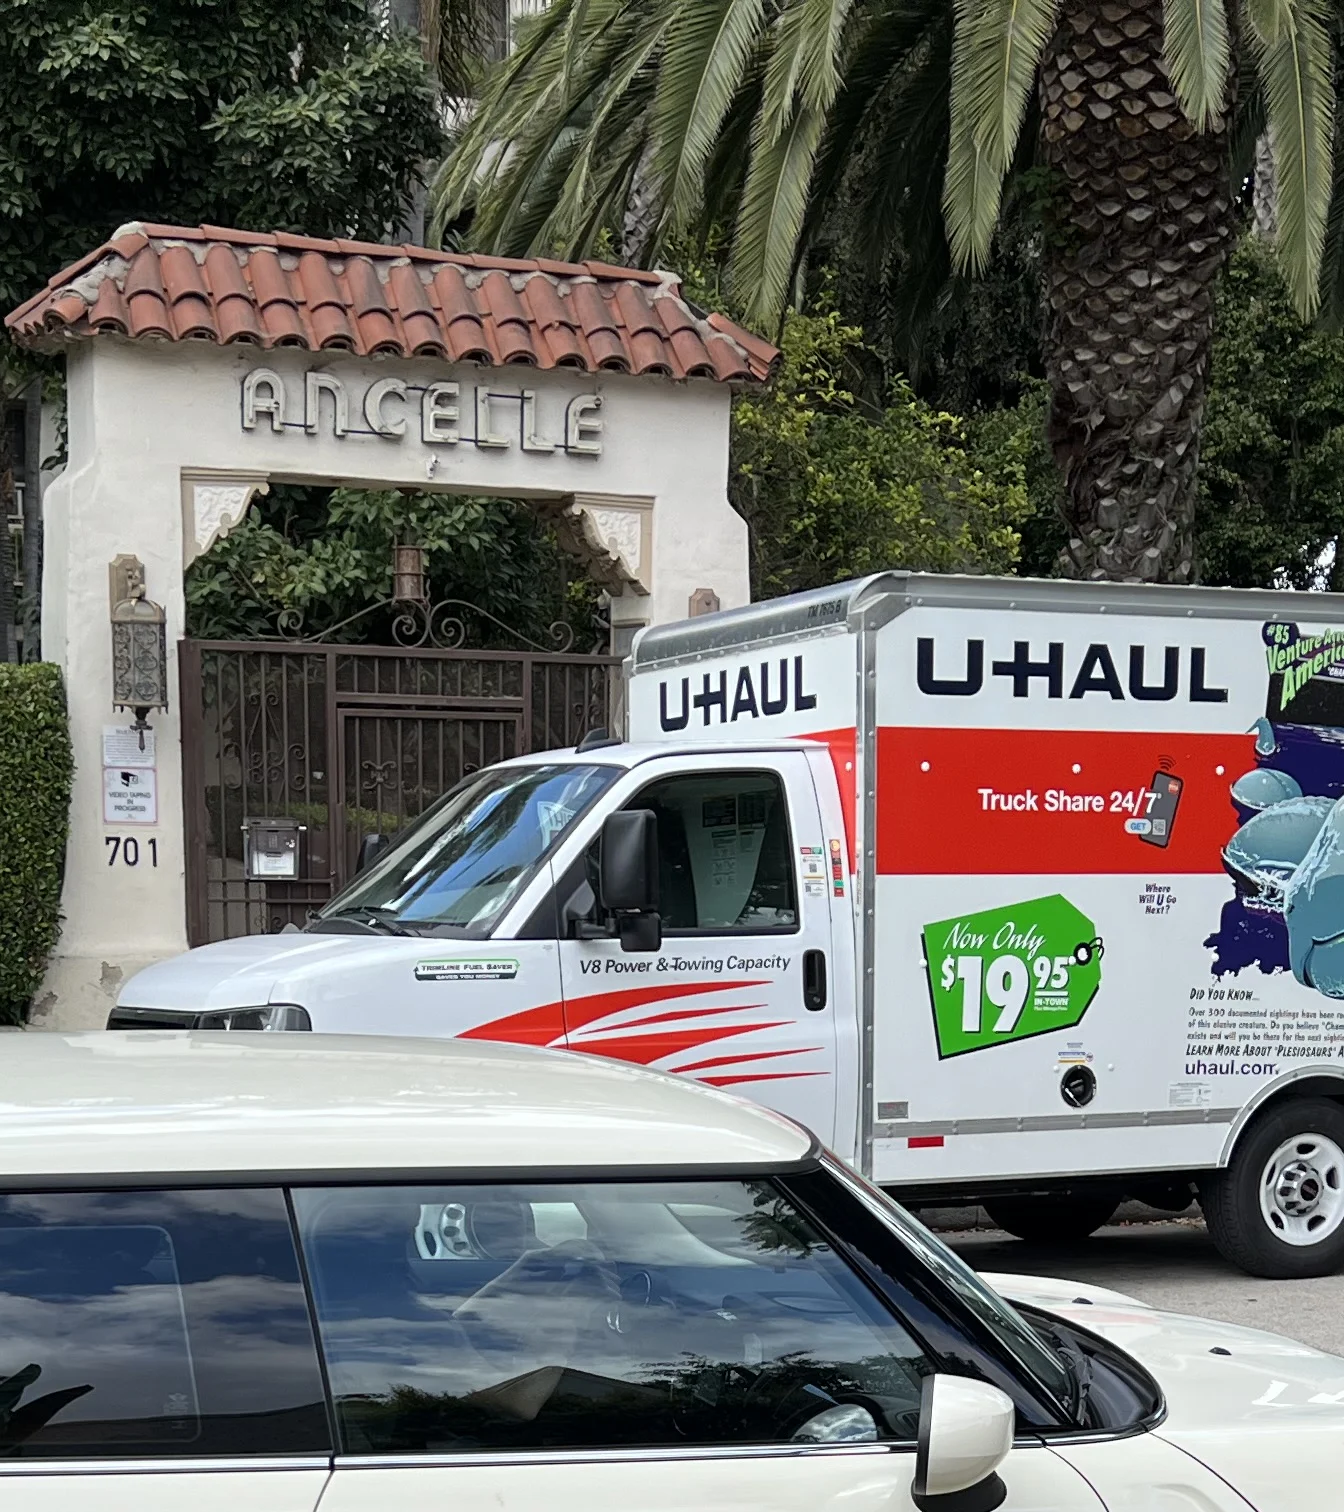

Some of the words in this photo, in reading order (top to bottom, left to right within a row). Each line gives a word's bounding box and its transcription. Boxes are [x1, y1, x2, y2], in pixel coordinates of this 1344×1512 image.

[241, 367, 604, 455] ANCELLE
[1266, 623, 1290, 644] #85
[1265, 634, 1323, 676] Venture
[917, 637, 1229, 703] U-HAUL
[659, 655, 817, 732] U-HAUL
[977, 788, 1039, 811] Truck
[1044, 789, 1105, 813] Share
[1130, 822, 1147, 832] GET
[105, 836, 158, 868] 701
[1145, 882, 1171, 893] Where
[1138, 894, 1155, 904] Will
[1156, 893, 1165, 906] U
[1166, 894, 1177, 904] Go
[1145, 904, 1171, 915] Next?
[943, 922, 989, 950] Now
[992, 921, 1047, 962] Only
[580, 958, 602, 974] V8
[605, 958, 653, 974] Power
[656, 957, 670, 972] &
[672, 956, 723, 974] Towing
[727, 954, 792, 972] Capacity
[1034, 997, 1069, 1006] IN-TOWN
[1188, 1006, 1206, 1017] Over
[1228, 1008, 1268, 1018] documented
[1302, 1009, 1317, 1019] have
[1319, 1010, 1335, 1019] been
[1188, 1020, 1196, 1028] of
[1198, 1020, 1211, 1028] this
[1270, 1020, 1280, 1029] Do
[1282, 1023, 1294, 1031] you
[1296, 1021, 1320, 1030] believe
[1209, 1032, 1222, 1040] and
[1239, 1033, 1250, 1042] you
[1252, 1032, 1261, 1041] be
[1282, 1032, 1292, 1041] for
[1294, 1032, 1305, 1041] the
